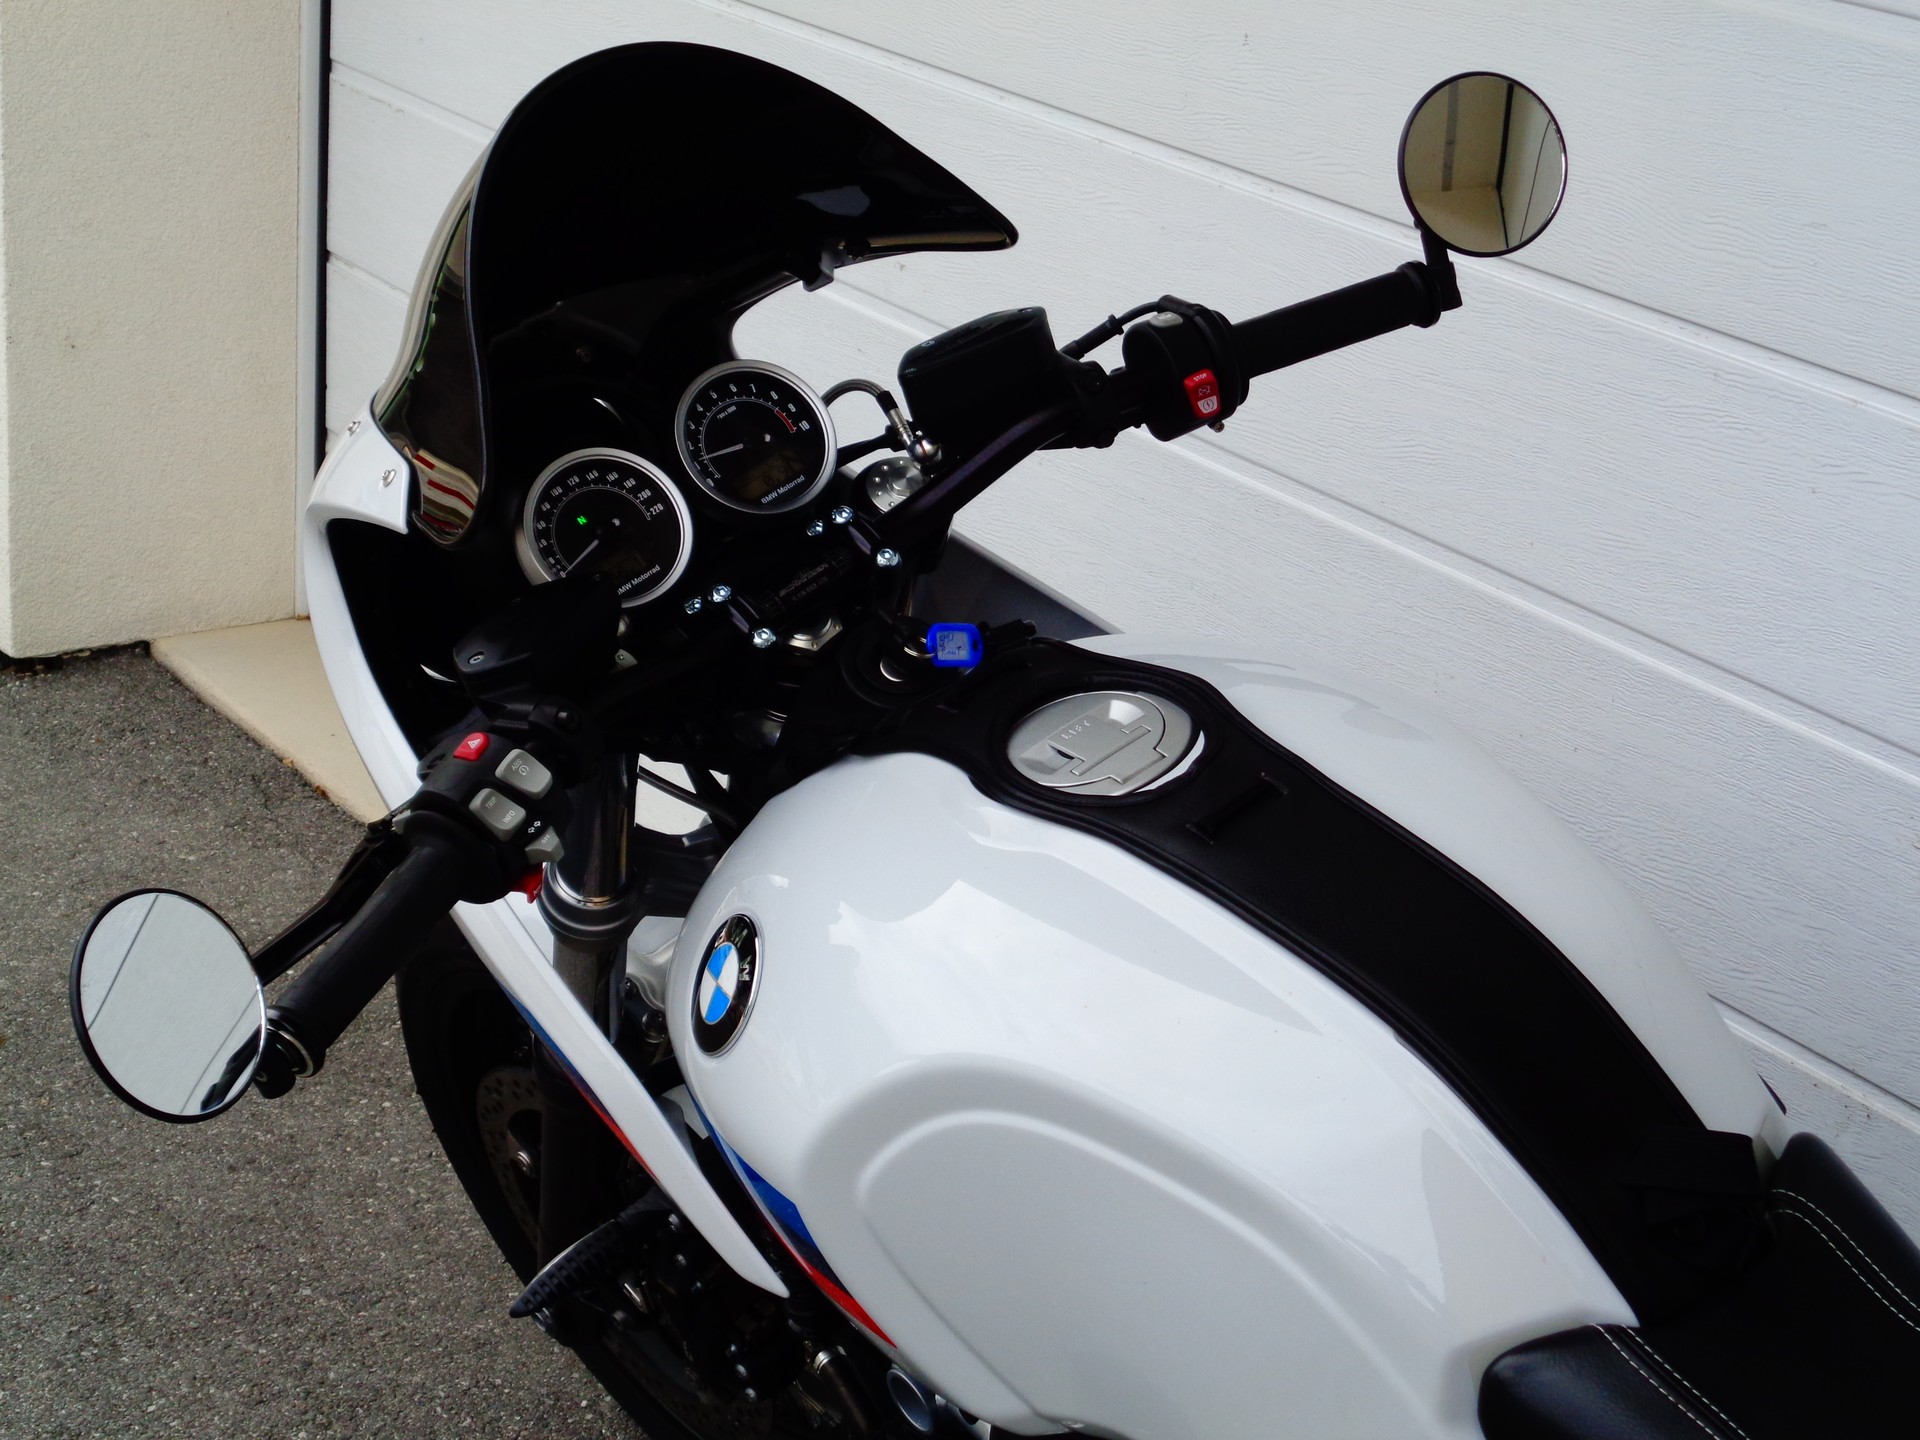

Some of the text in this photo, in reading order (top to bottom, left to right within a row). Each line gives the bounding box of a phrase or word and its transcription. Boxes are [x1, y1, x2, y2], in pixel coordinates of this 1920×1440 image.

[1193, 373, 1207, 382] STOP
[729, 383, 737, 393] 6
[749, 383, 757, 393] 7
[709, 390, 718, 399] 5
[769, 390, 779, 400] 8
[695, 403, 704, 412] 4
[787, 403, 796, 413] 9
[687, 420, 696, 430] 3
[798, 420, 810, 431] 10
[687, 440, 695, 450] 2
[585, 469, 599, 481] 140
[605, 471, 619, 483] 160
[567, 475, 580, 487] 120
[623, 477, 636, 489] 180
[550, 485, 563, 497] 100
[637, 489, 652, 501] 200
[761, 490, 778, 505] BMW
[777, 475, 805, 495] Motorrad
[540, 501, 551, 512] 80
[650, 502, 664, 515] 220
[576, 515, 587, 525] N
[631, 564, 661, 586] Motorrad
[511, 758, 523, 772] ABS
[485, 796, 496, 809] TRIP
[502, 810, 516, 824] INFO
[541, 834, 551, 844] OFF
